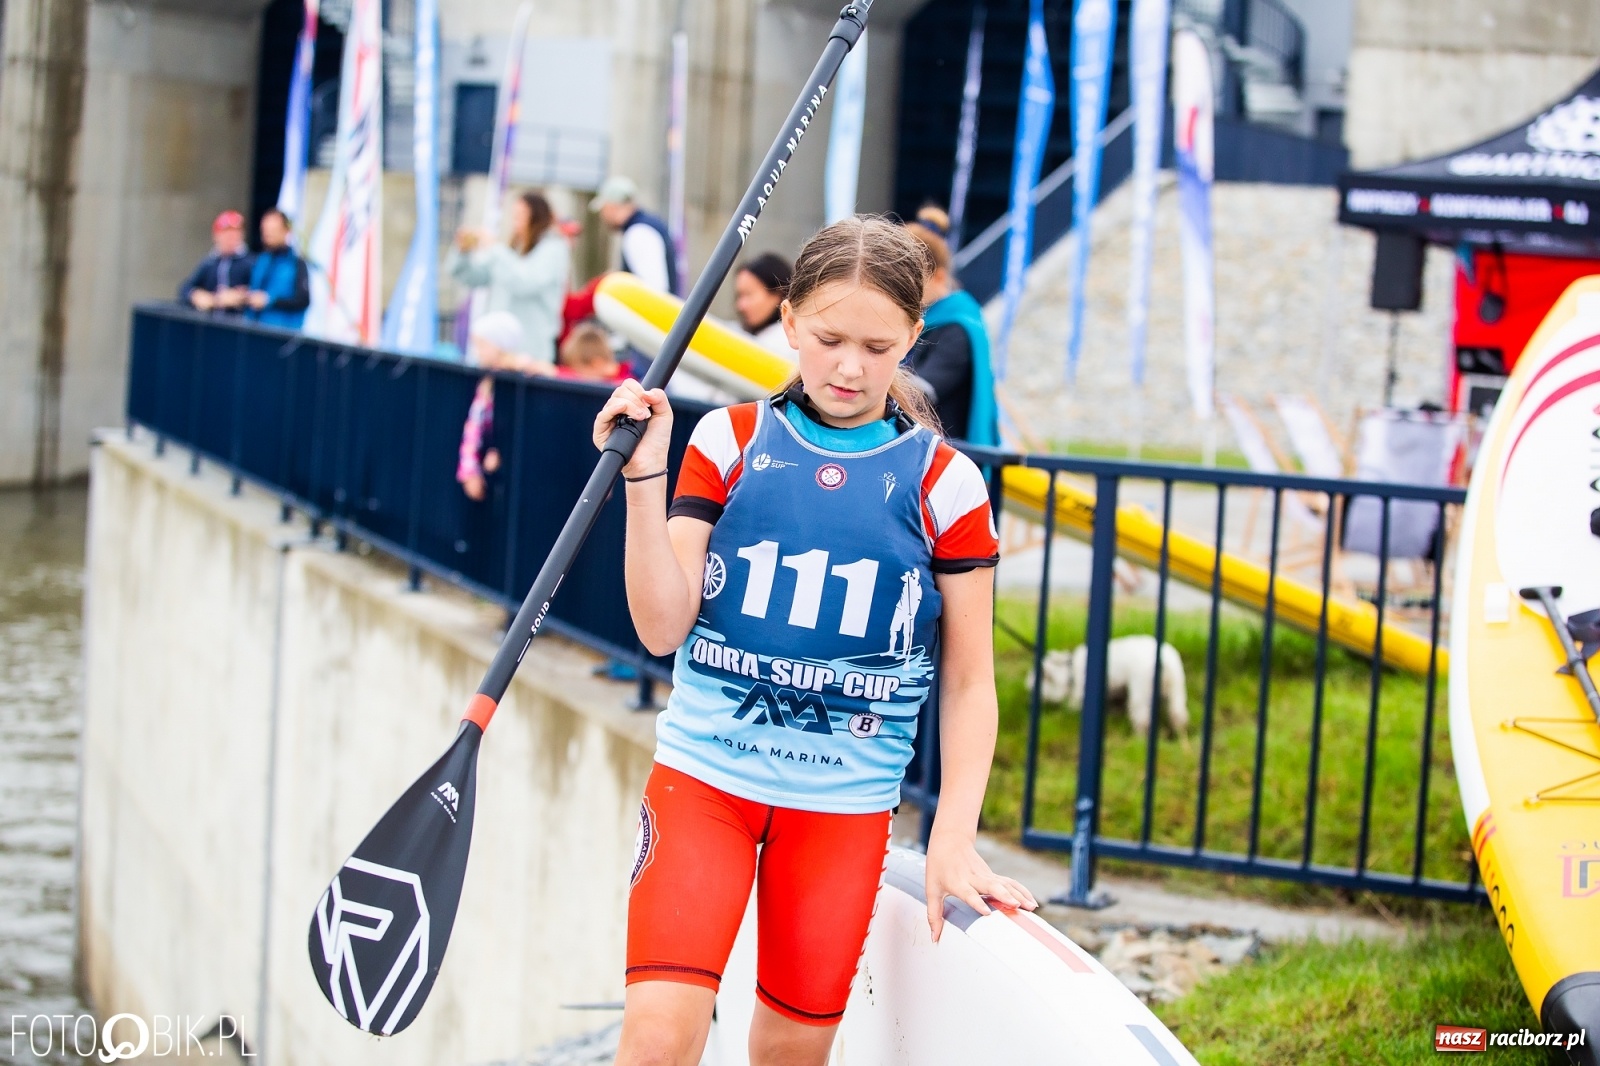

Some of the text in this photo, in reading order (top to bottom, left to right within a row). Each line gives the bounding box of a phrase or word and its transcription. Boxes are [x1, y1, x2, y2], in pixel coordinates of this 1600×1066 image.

[757, 159, 787, 211] AQUA
[786, 84, 828, 155] MARINA
[531, 601, 550, 635] SOLID
[737, 539, 879, 638] 111
[692, 637, 900, 702] ODRA SUP CUP
[712, 735, 844, 767] AQUA MARINA
